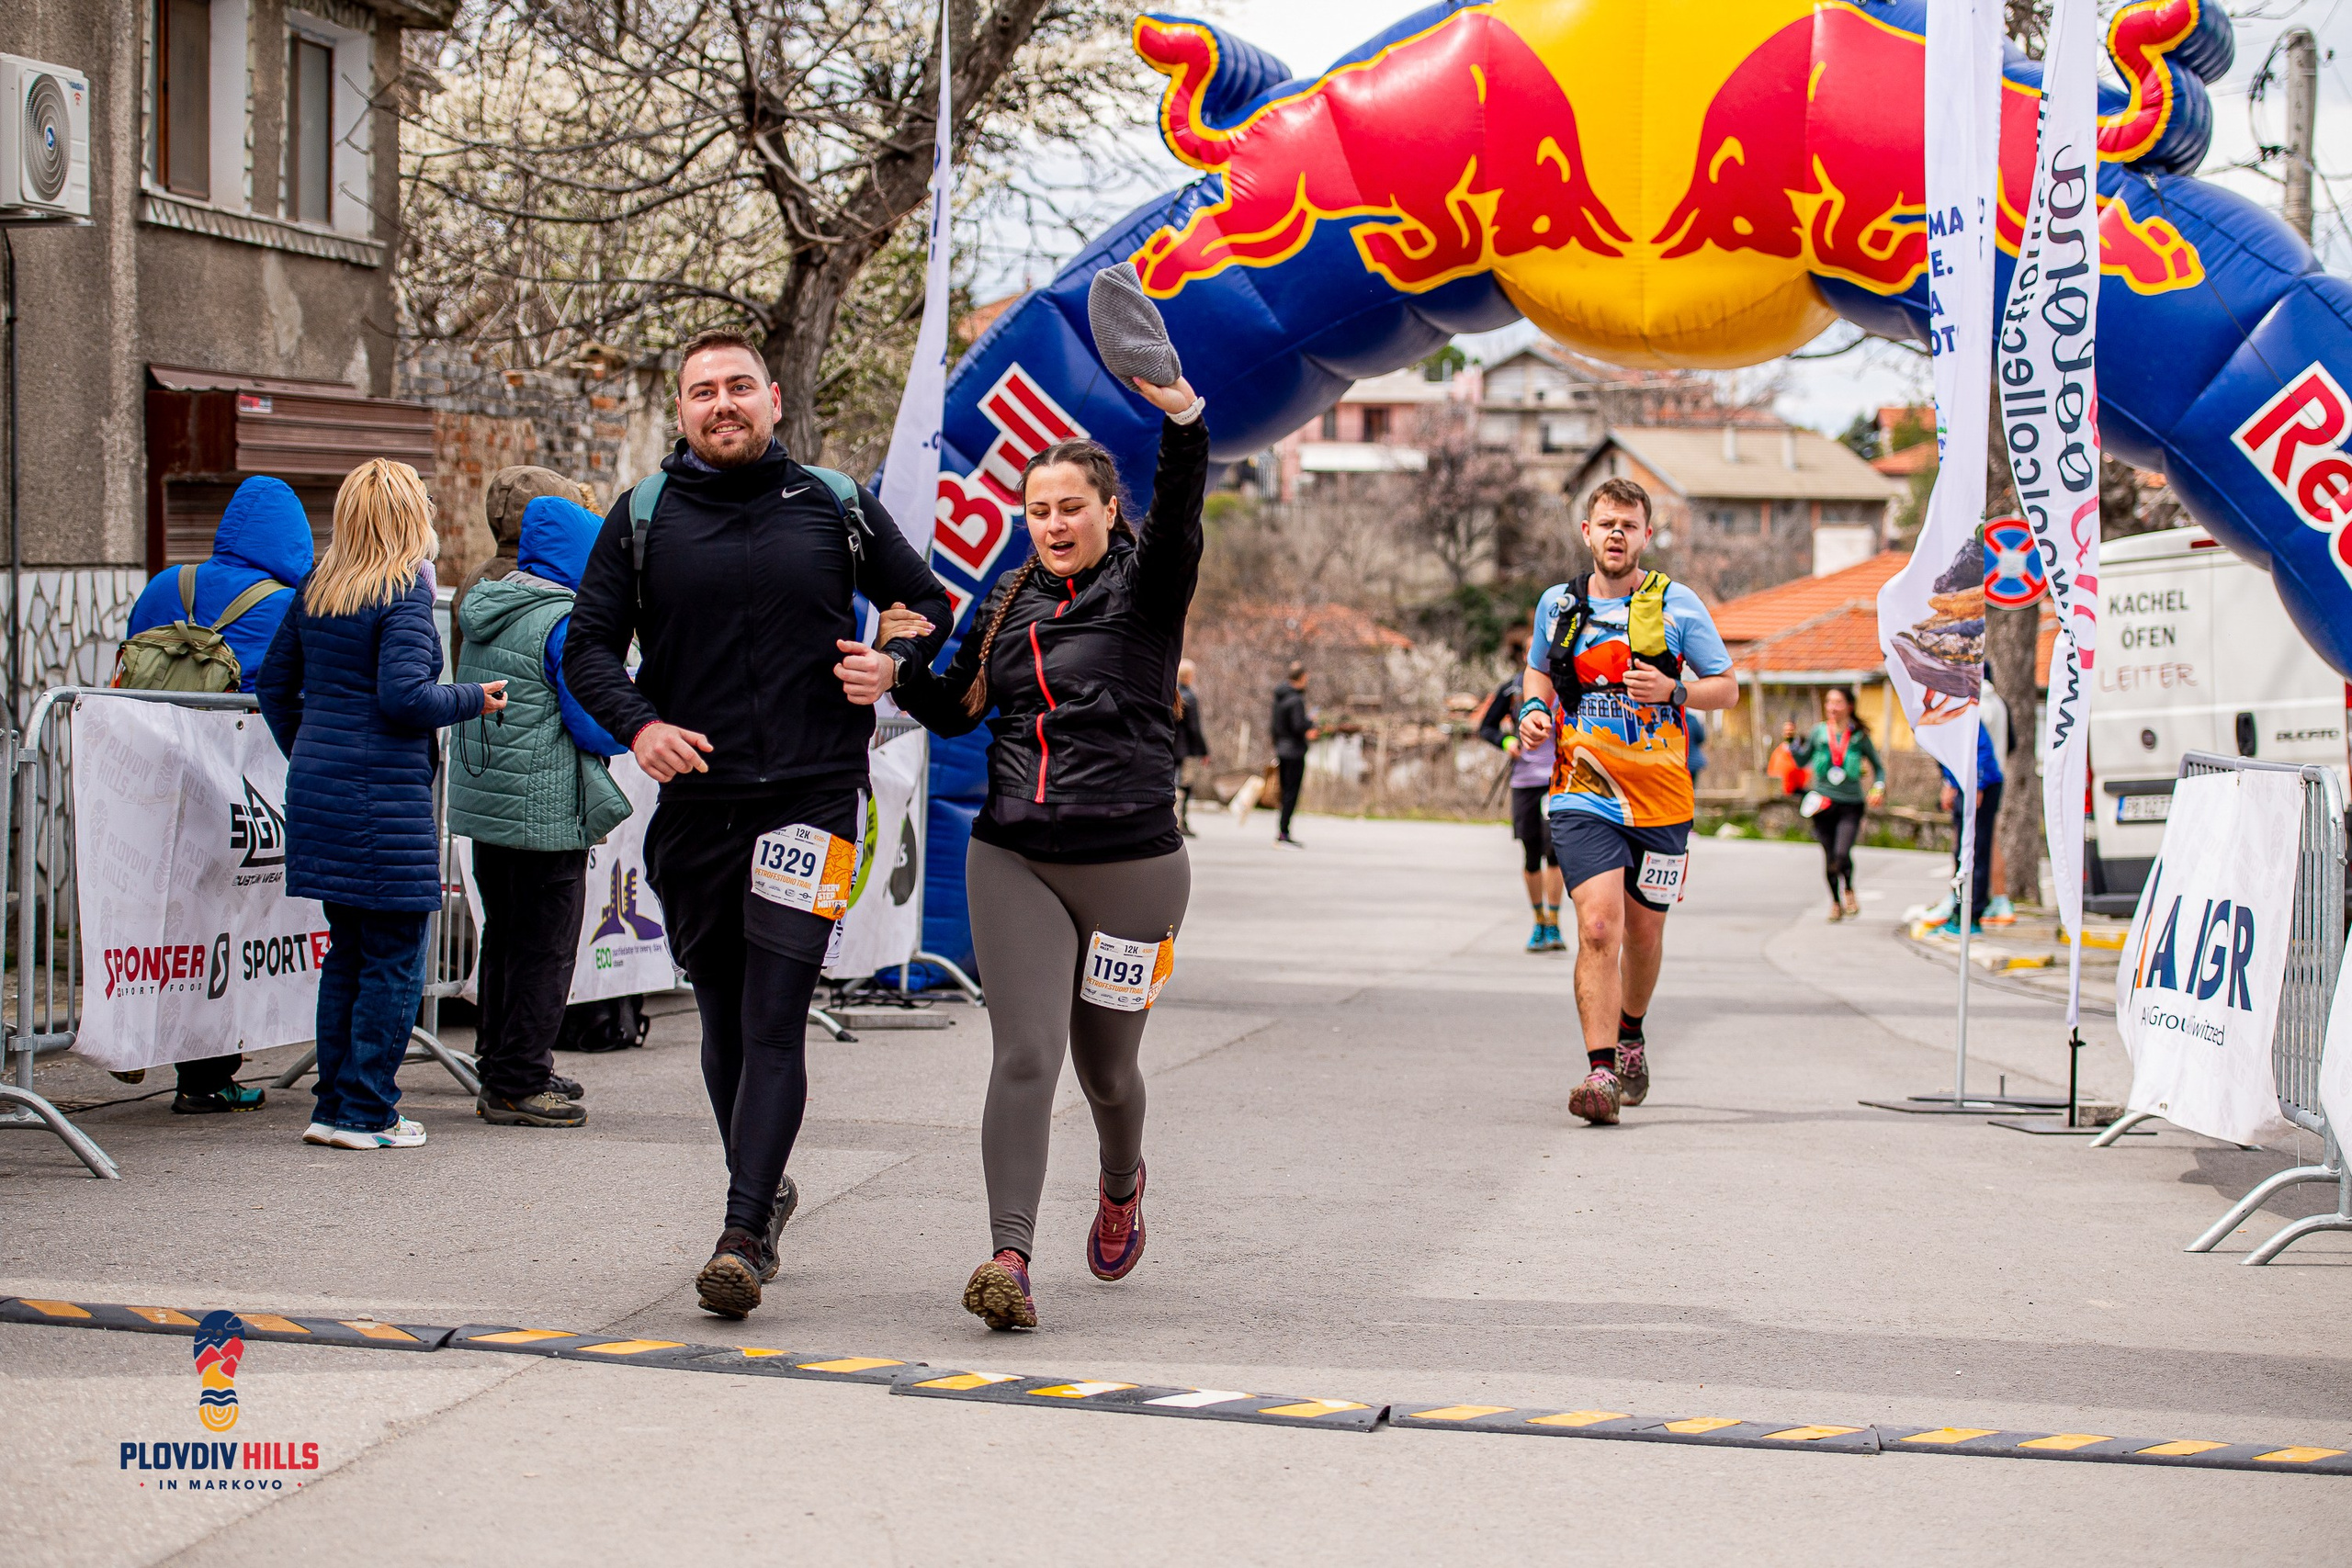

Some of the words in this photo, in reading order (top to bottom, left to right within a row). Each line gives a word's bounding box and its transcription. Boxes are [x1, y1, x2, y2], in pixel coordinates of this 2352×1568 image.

[2108, 589, 2190, 615] KACHEL
[2120, 622, 2177, 649] ÖFEN
[2098, 662, 2199, 694] LEITER
[795, 828, 811, 840] 12K
[760, 840, 817, 878] 1329
[1645, 868, 1679, 886] 2113
[595, 946, 612, 970] ECO
[1125, 944, 1139, 954] 12K
[104, 944, 206, 1001] SPONSER
[243, 933, 308, 981] SPORT
[1093, 953, 1144, 986] 1193
[169, 982, 202, 993] FOOD
